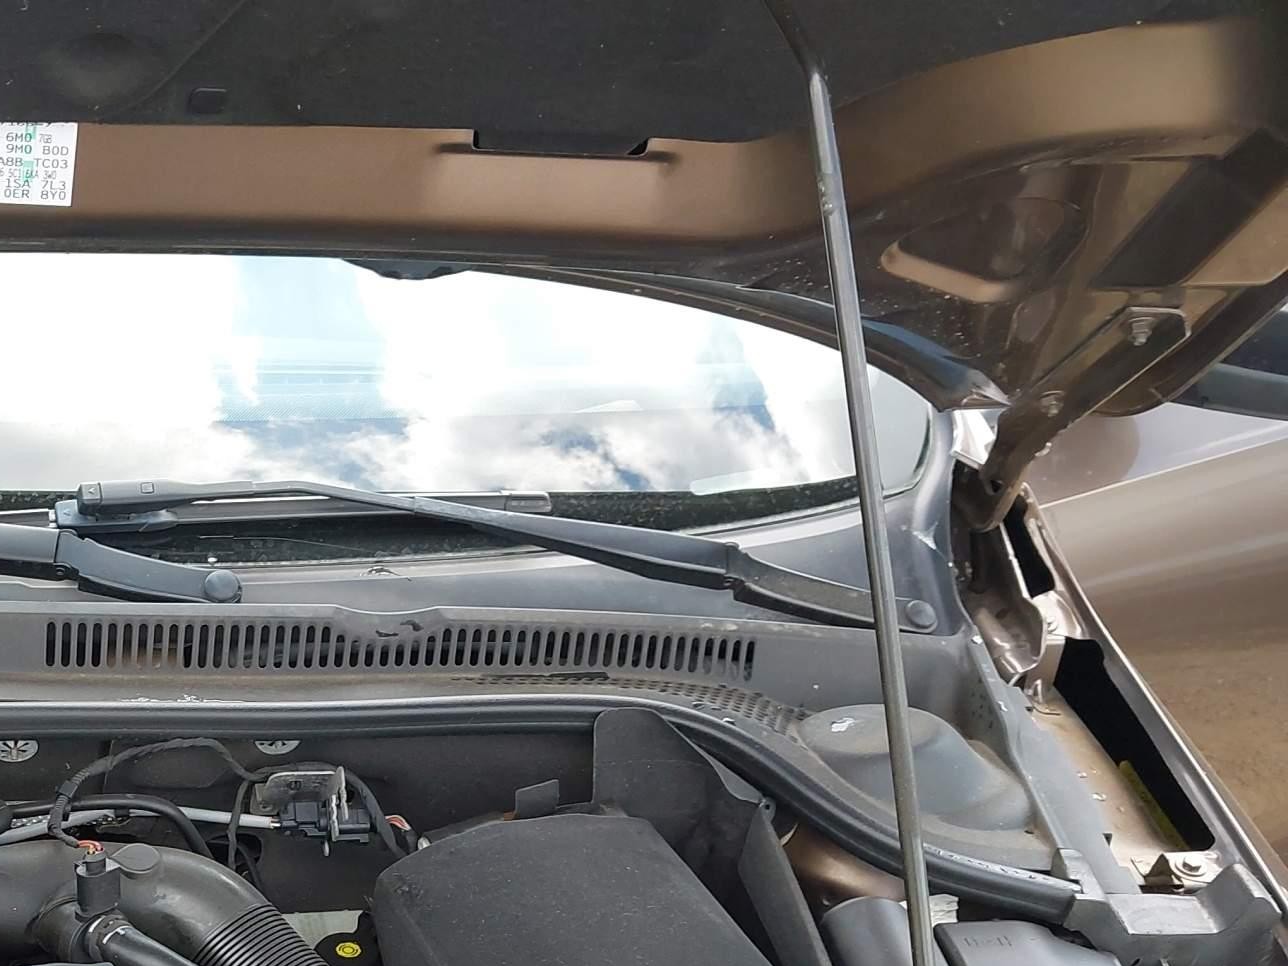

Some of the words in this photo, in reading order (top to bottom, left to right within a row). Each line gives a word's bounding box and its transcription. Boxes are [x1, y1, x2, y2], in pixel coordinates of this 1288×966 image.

[6, 132, 33, 143] 6M0
[6, 143, 33, 154] 9M0
[33, 158, 69, 169] TC03
[41, 180, 66, 191] 7L3
[4, 188, 30, 199] 0ER
[40, 190, 66, 201] 8Y0
